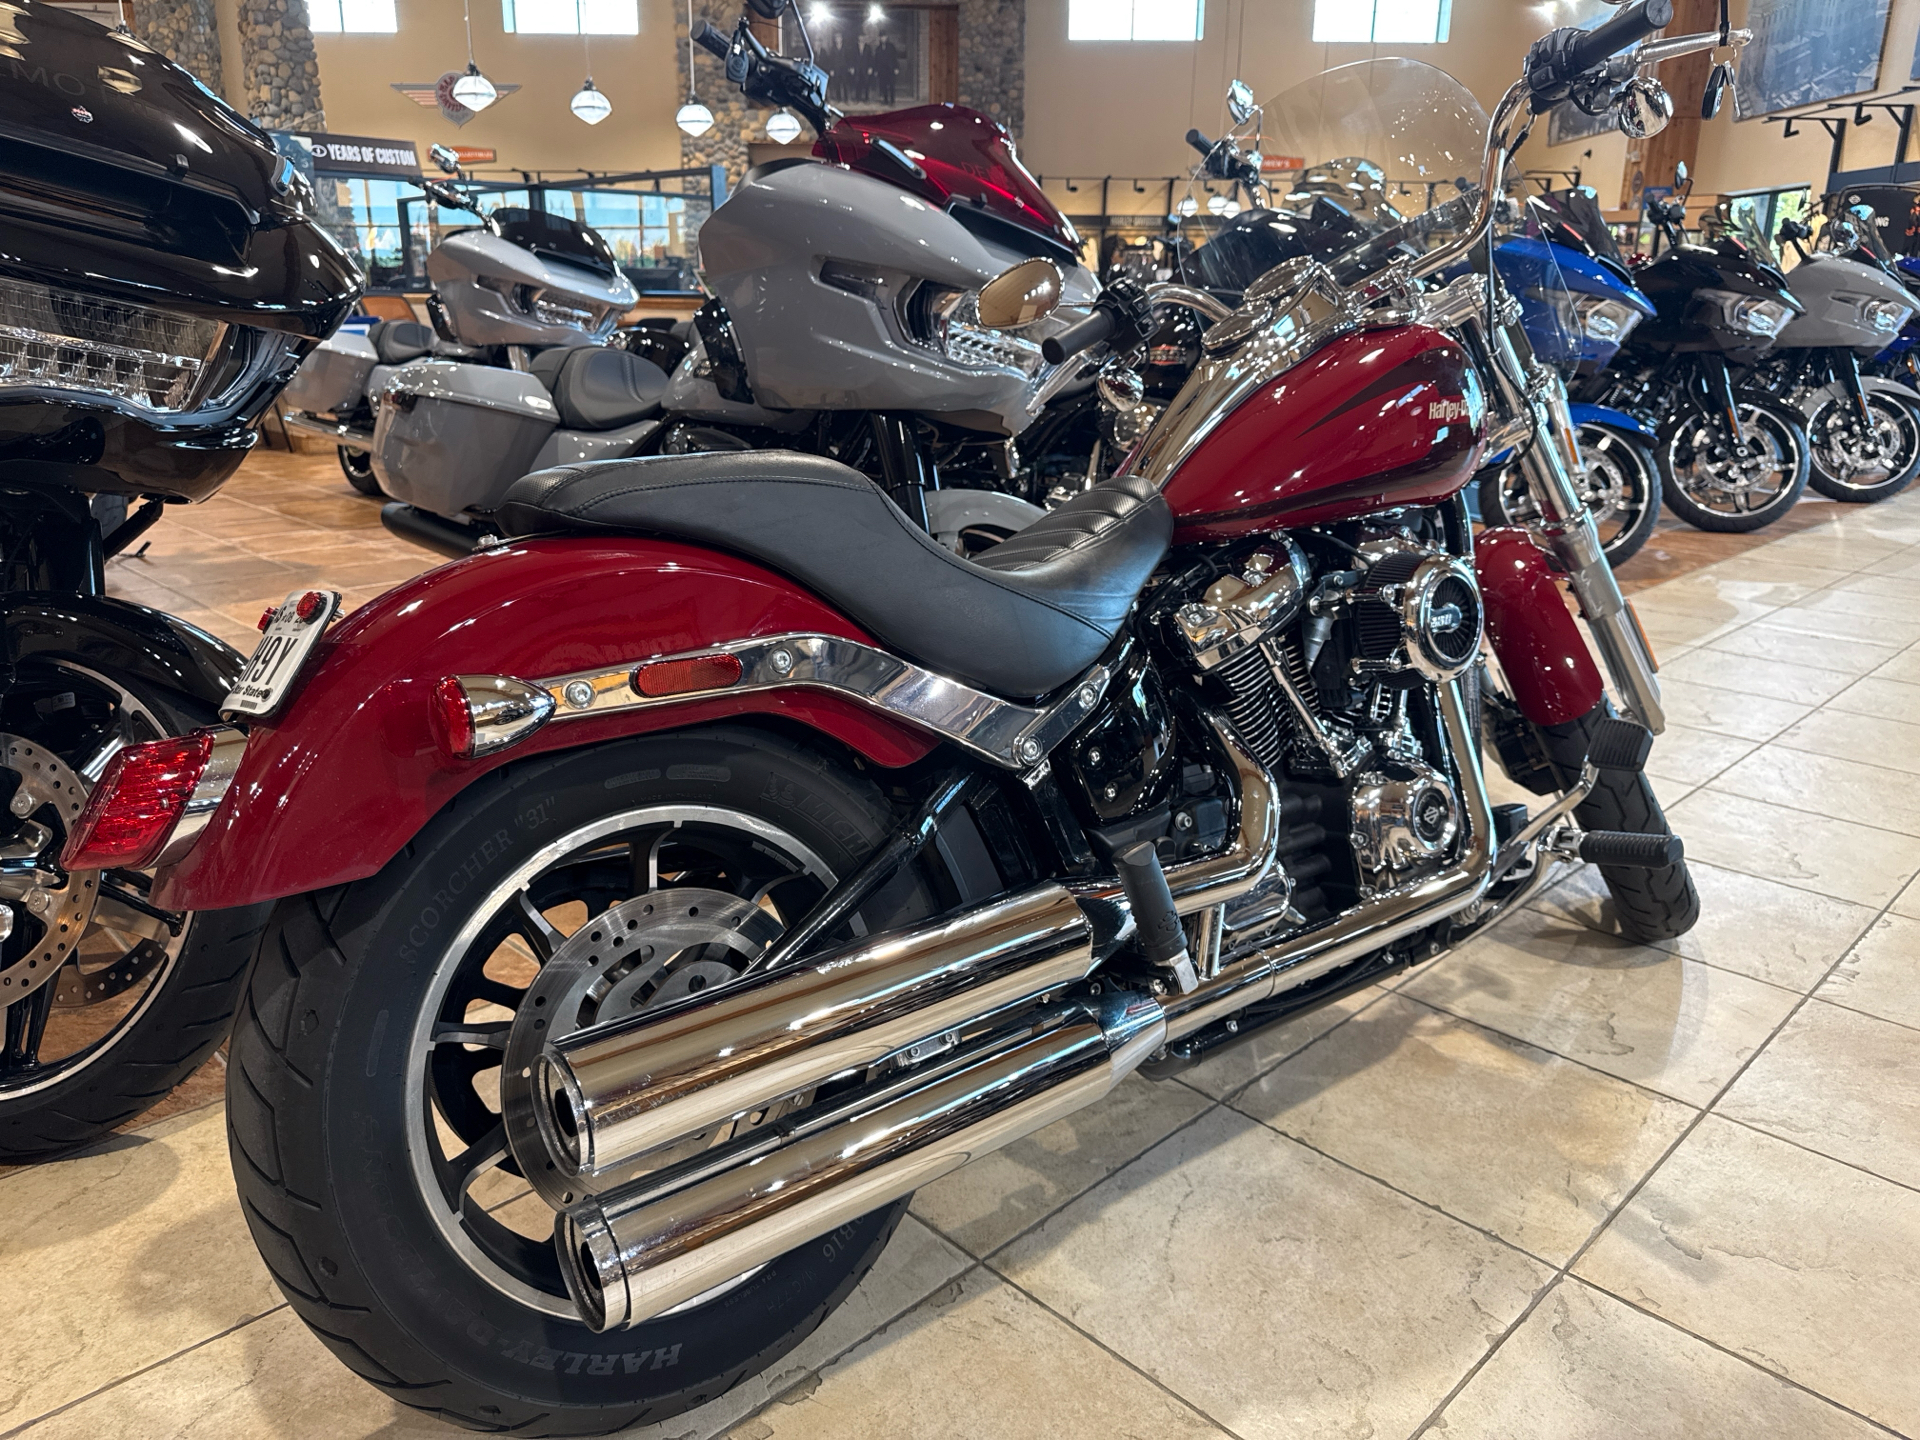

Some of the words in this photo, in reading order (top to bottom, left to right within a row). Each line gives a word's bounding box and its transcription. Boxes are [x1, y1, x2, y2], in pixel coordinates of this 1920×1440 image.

[326, 143, 361, 162] YEARS
[361, 146, 374, 163] OF
[375, 148, 416, 166] CUSTOM
[237, 635, 299, 686] H9Y
[399, 828, 515, 965] SCORCHER
[513, 796, 556, 831] "31"
